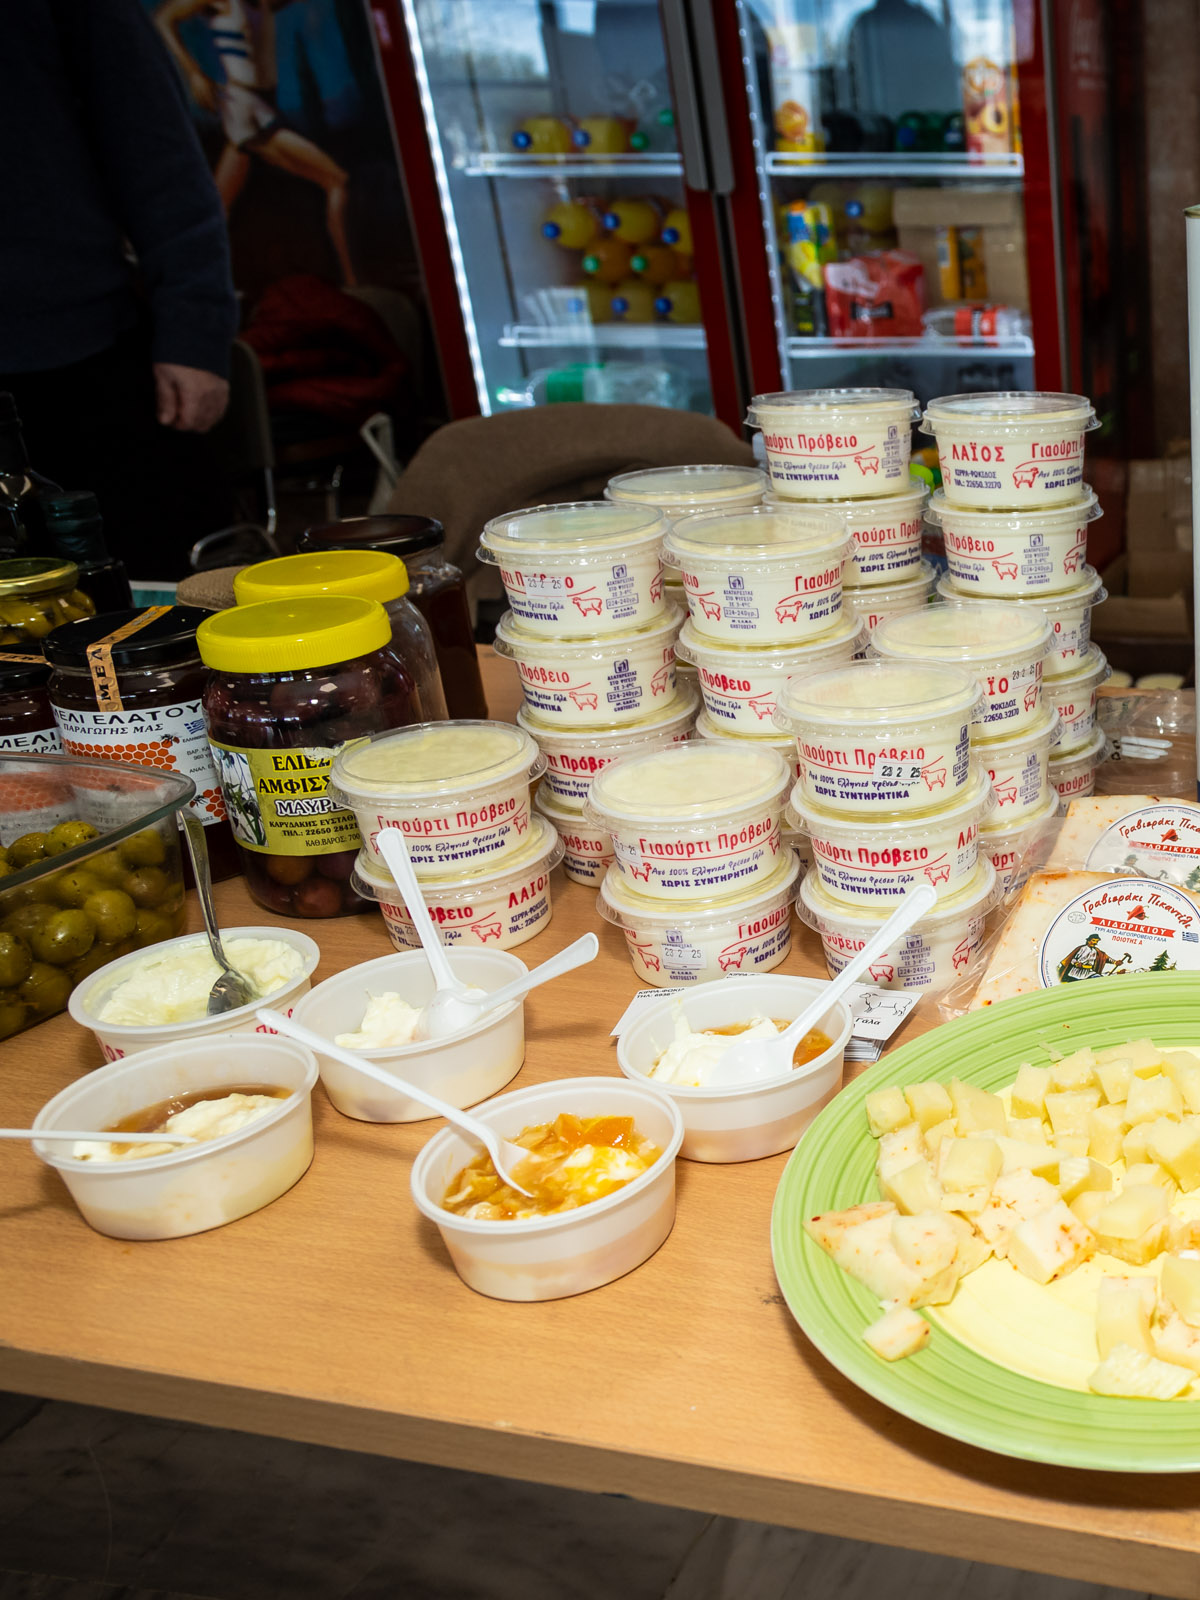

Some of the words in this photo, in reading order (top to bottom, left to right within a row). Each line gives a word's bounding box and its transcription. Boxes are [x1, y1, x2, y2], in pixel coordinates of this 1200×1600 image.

[798, 434, 857, 452] Πρόβειο
[1032, 440, 1078, 458] Γιαούρτι
[952, 442, 1005, 462] ΛΑΪΟΣ
[786, 473, 839, 481] ΣΥΝΤΗΡΗΤΙΚΑ
[1045, 480, 1065, 489] ΧΩΡΙΣ
[949, 532, 994, 553] Πρόβειο
[860, 564, 885, 572] ΧΩΡΙΣ
[795, 568, 840, 591] Γιαούρτι
[809, 608, 829, 621] ΧΩΡΙΣ
[520, 662, 570, 685] Πρόβειο
[702, 668, 751, 692] Πρόβειο
[93, 701, 201, 725] ΕΛΑΤΟΥ
[63, 723, 129, 735] ΠΑΡΑΓΩΓΗΣ
[133, 723, 163, 734] ΜΑΣ
[798, 737, 847, 767] Γιαούρτι
[881, 766, 893, 777] 23
[896, 767, 902, 777] 2
[910, 767, 921, 778] 25
[814, 785, 837, 798] ΧΩΡΙΣ
[839, 790, 910, 801] ΣΥΝΤΗΡΗΤΙΚΑ
[457, 797, 516, 828] Πρόβειο
[269, 820, 318, 828] ΚΑΡΥΔΑΚΗΣ
[320, 815, 356, 826] ΕΥΣΤΑΘ
[1119, 818, 1174, 838] Γραβιεράκι
[305, 828, 331, 836] 22650
[639, 838, 711, 858] Γιαούρτι
[718, 817, 772, 849] Πρόβειο
[412, 843, 432, 852] 100%
[439, 839, 505, 862] ΣΥΝΤΗΡΗΤΙΚΑ
[858, 847, 929, 867] Πρόβειο
[661, 879, 691, 888] ΧΩΡΙΣ
[694, 863, 759, 887] ΣΥΝΤΗΡΗΤΙΚΑ
[669, 867, 689, 876] 100%
[691, 863, 726, 876] Ελληνικό
[841, 882, 906, 896] ΣΥΝΤΗΡΗΤΙΚΑ
[1083, 893, 1143, 914] Γραβιεράκι
[738, 906, 787, 939] Γιαούρτι
[1099, 919, 1167, 935] ΛΙΔΩΡΙΚΙΟΥ
[1112, 936, 1137, 944] ΠΟΙΟΤΗΣ
[1118, 930, 1153, 940] ΑΙΓΟΠΡΟΒΕΙΟ
[665, 949, 674, 958] 23
[678, 949, 684, 958] 2
[691, 949, 702, 959] 25
[754, 949, 776, 964] ΧΩΡΙΣ
